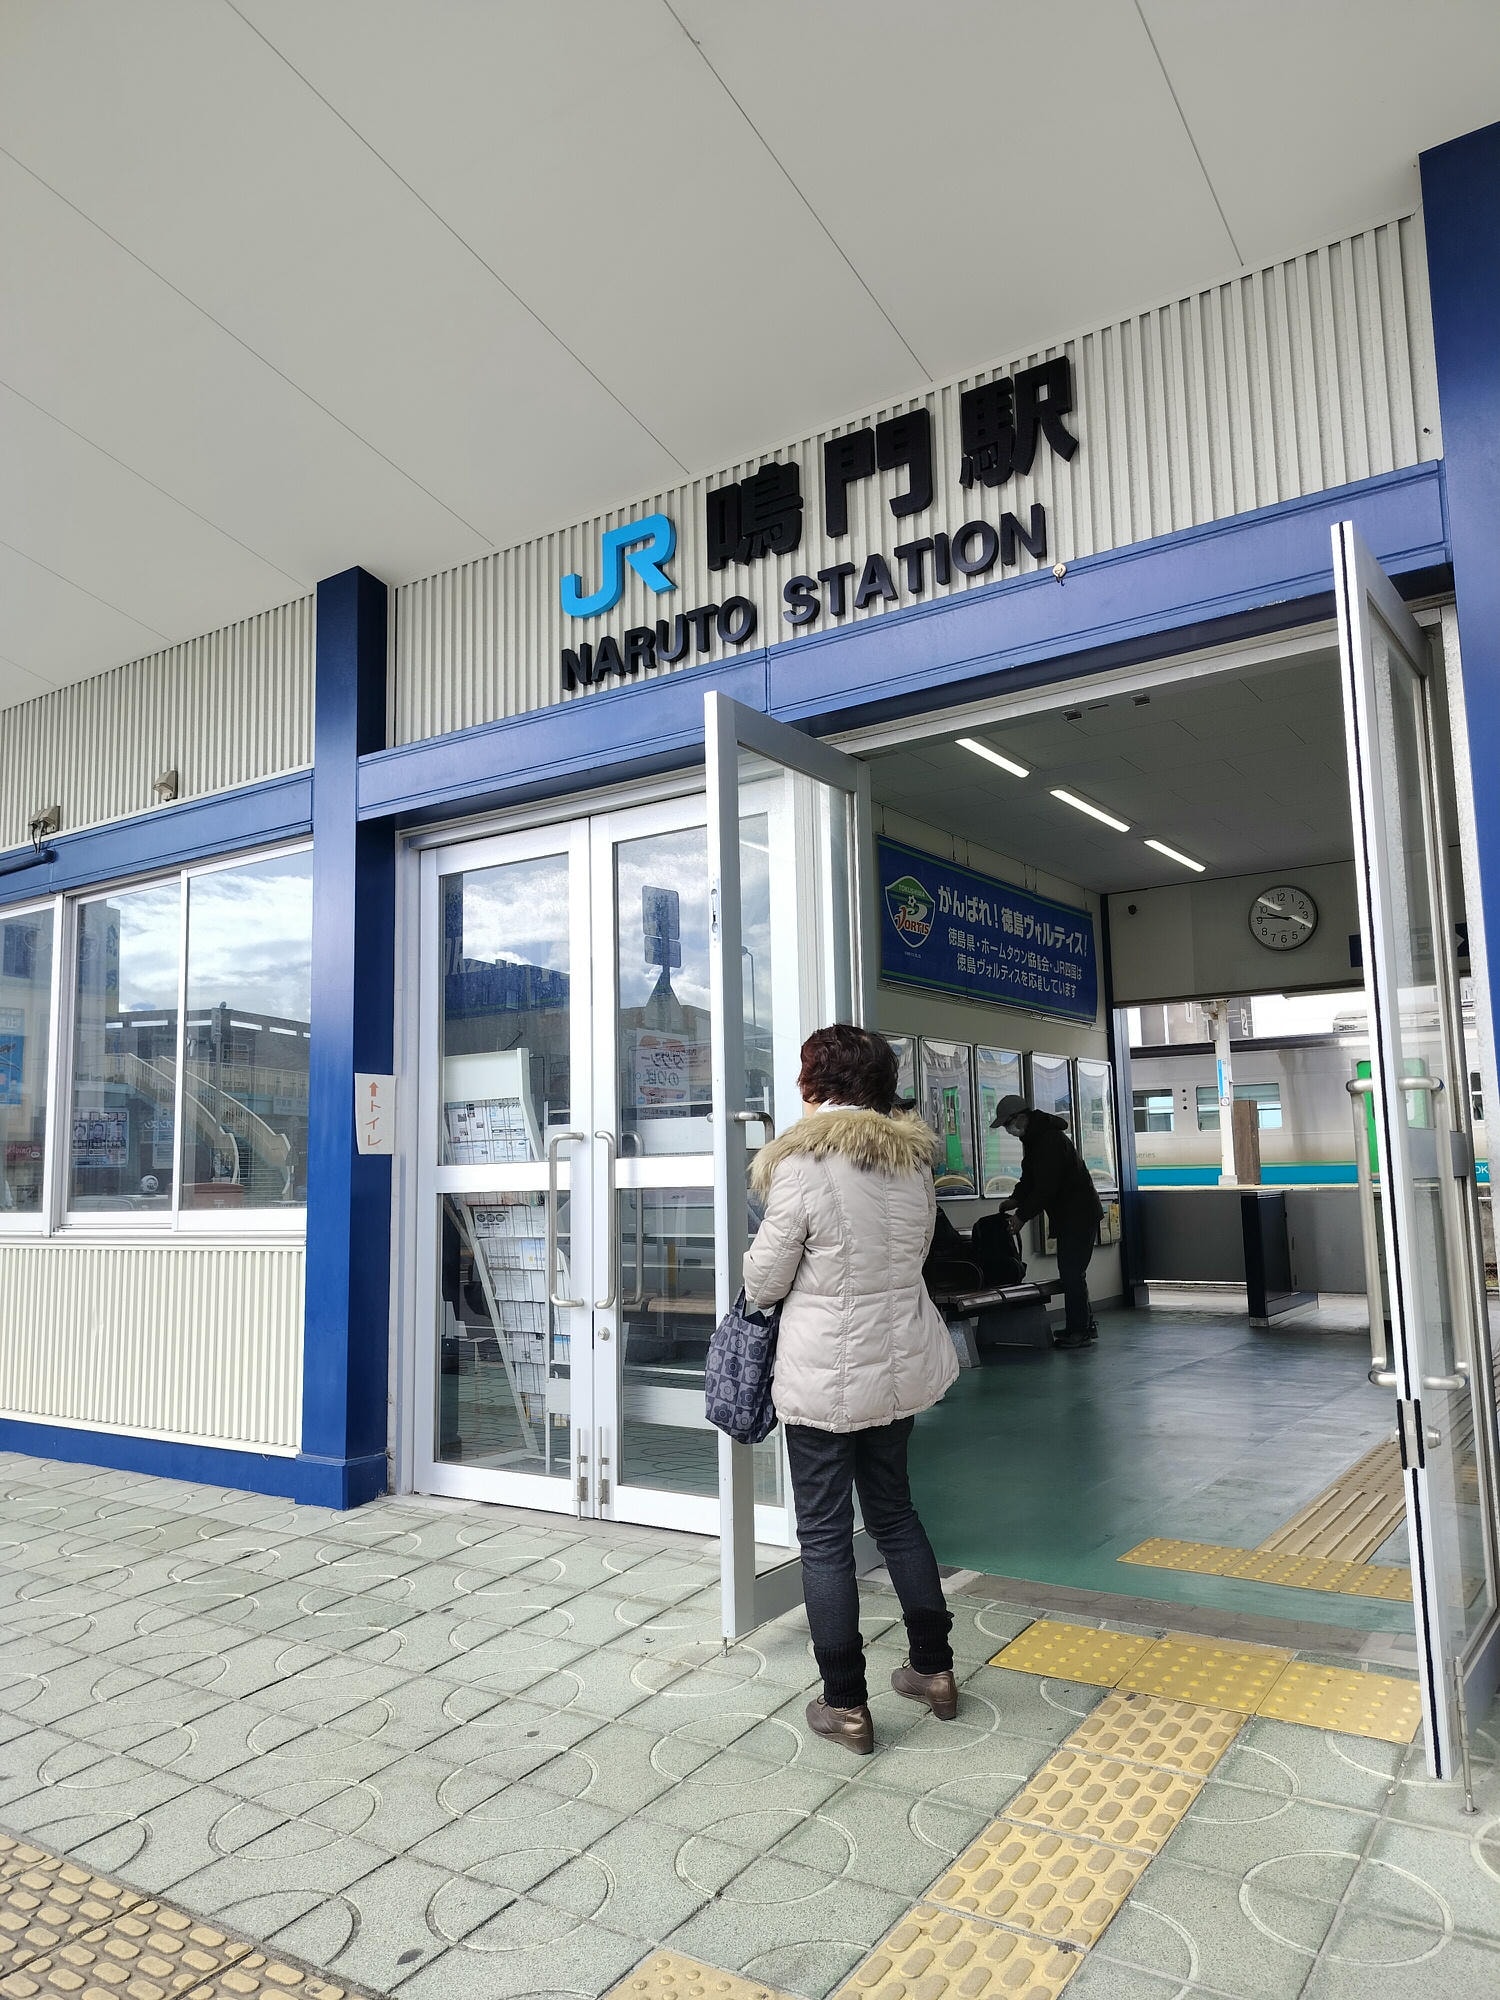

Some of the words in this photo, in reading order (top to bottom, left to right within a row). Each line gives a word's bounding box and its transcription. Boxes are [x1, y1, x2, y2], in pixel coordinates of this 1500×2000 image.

[561, 513, 678, 618] JR
[706, 355, 1079, 571] 鳴門駅
[561, 596, 757, 691] NARUTO
[783, 503, 1048, 625] STATION
[1277, 893, 1285, 901] 12
[1298, 901, 1305, 909] 2
[1303, 911, 1308, 919] 3
[895, 905, 930, 935] VORTIS
[1262, 928, 1268, 936] 8
[1292, 931, 1298, 939] 5
[1271, 934, 1276, 942] 7
[1281, 935, 1287, 943] 6
[366, 1100, 383, 1146] トイレ
